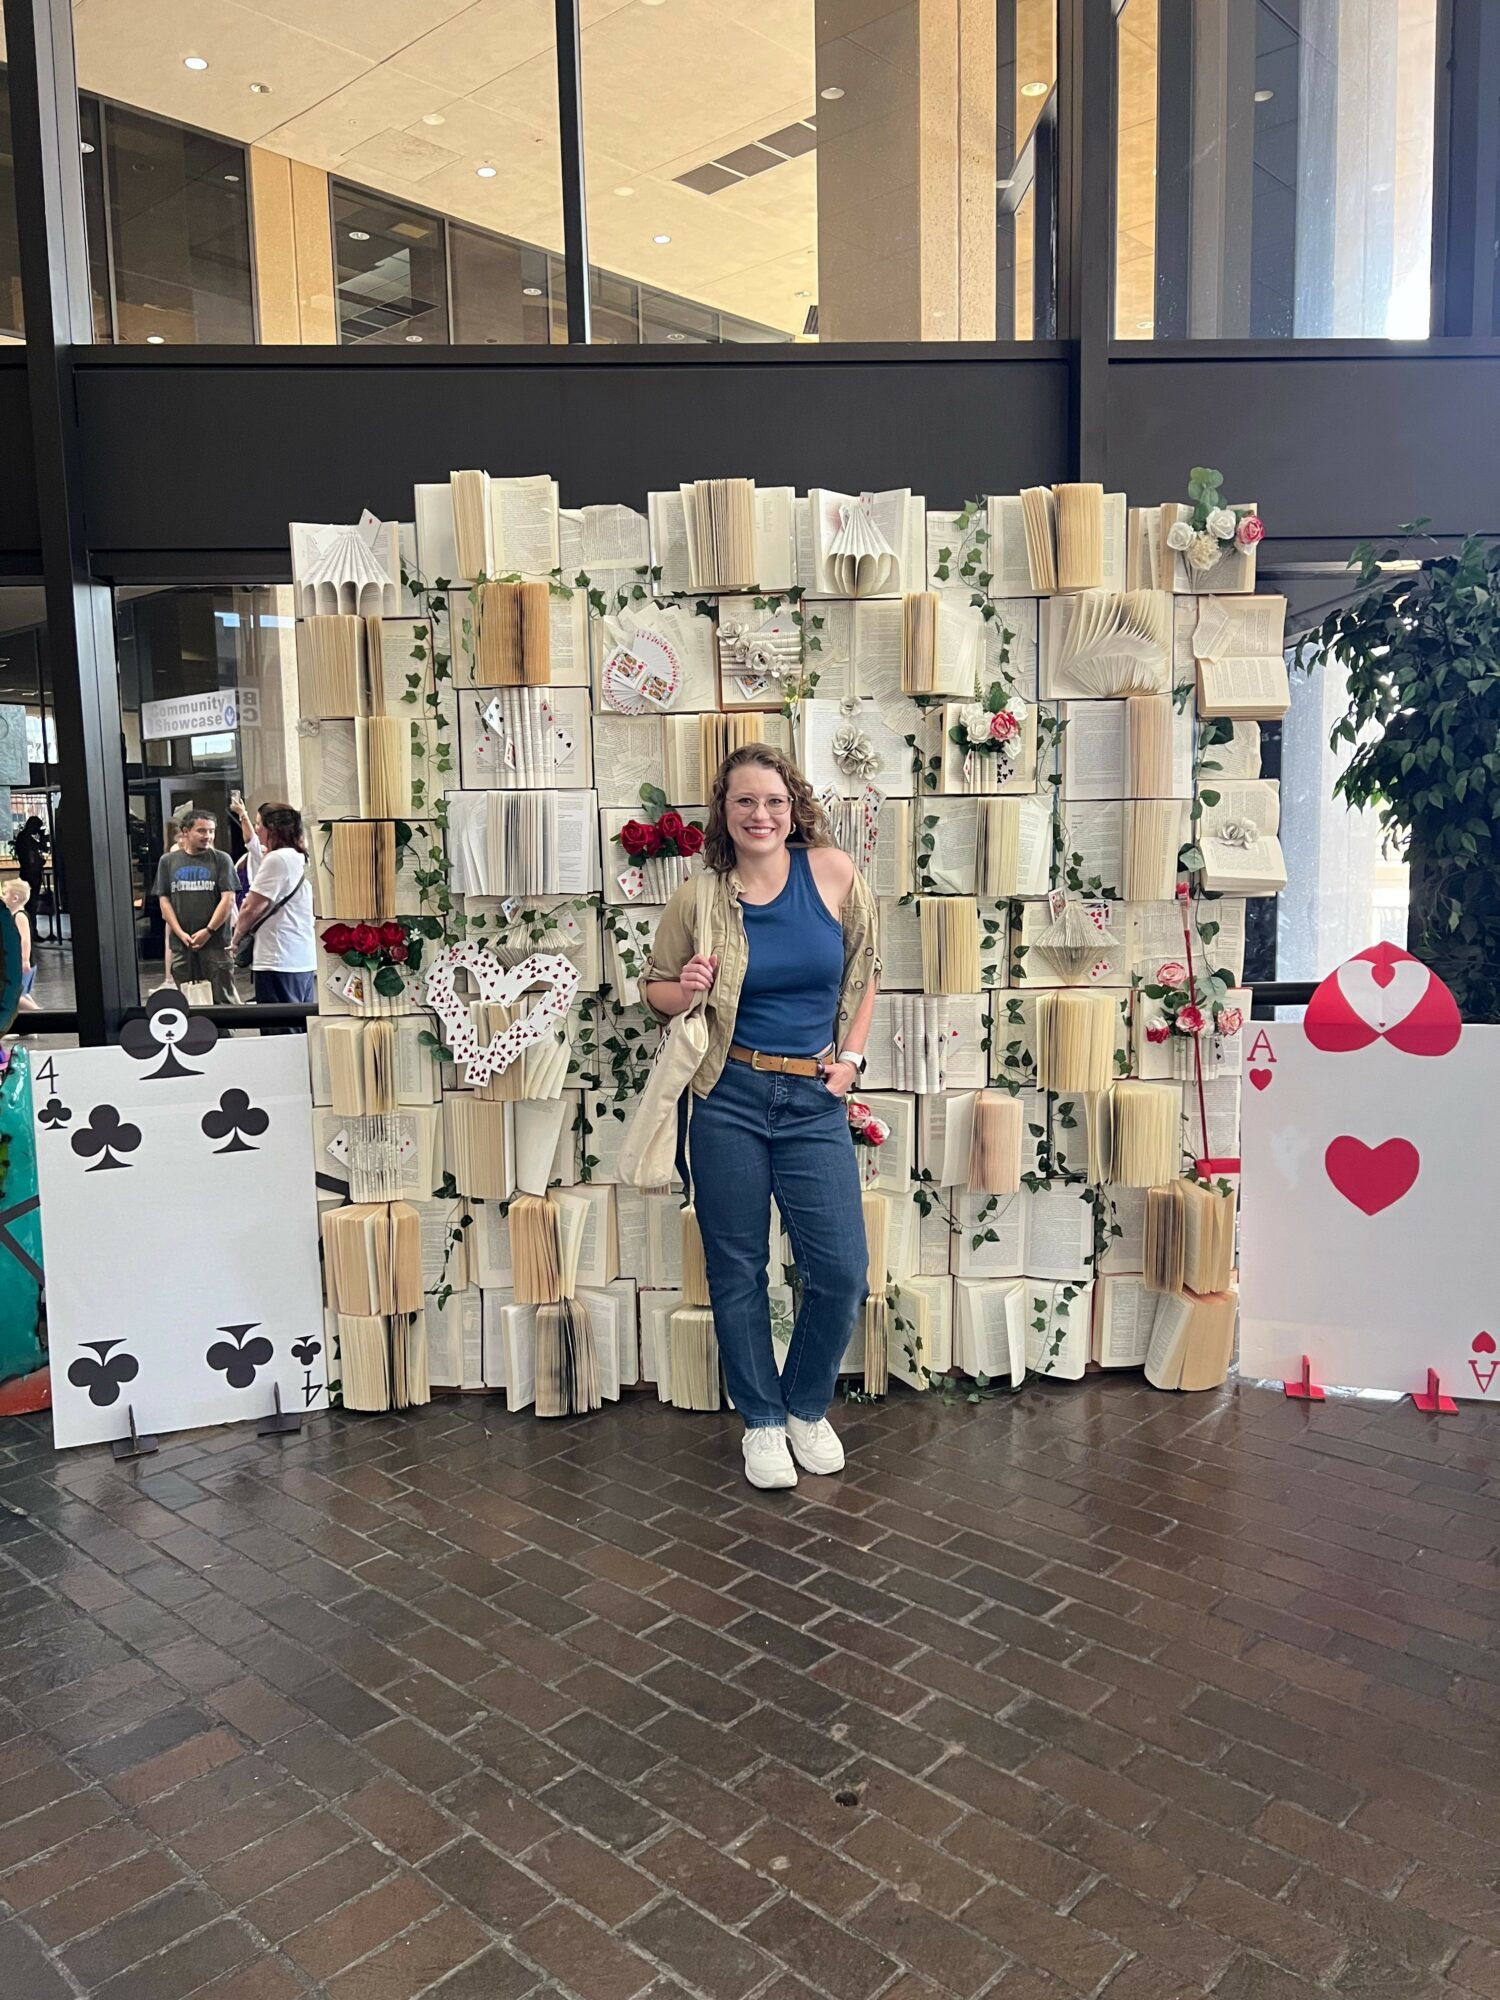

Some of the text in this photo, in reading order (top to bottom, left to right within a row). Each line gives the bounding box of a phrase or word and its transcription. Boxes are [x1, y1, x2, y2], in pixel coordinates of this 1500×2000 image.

[151, 696, 225, 718] Community
[155, 714, 223, 732] Showcase
[1247, 1028, 1277, 1063] A
[36, 1055, 59, 1094] 4
[301, 1370, 323, 1408] 4
[1468, 1359, 1500, 1394] A
